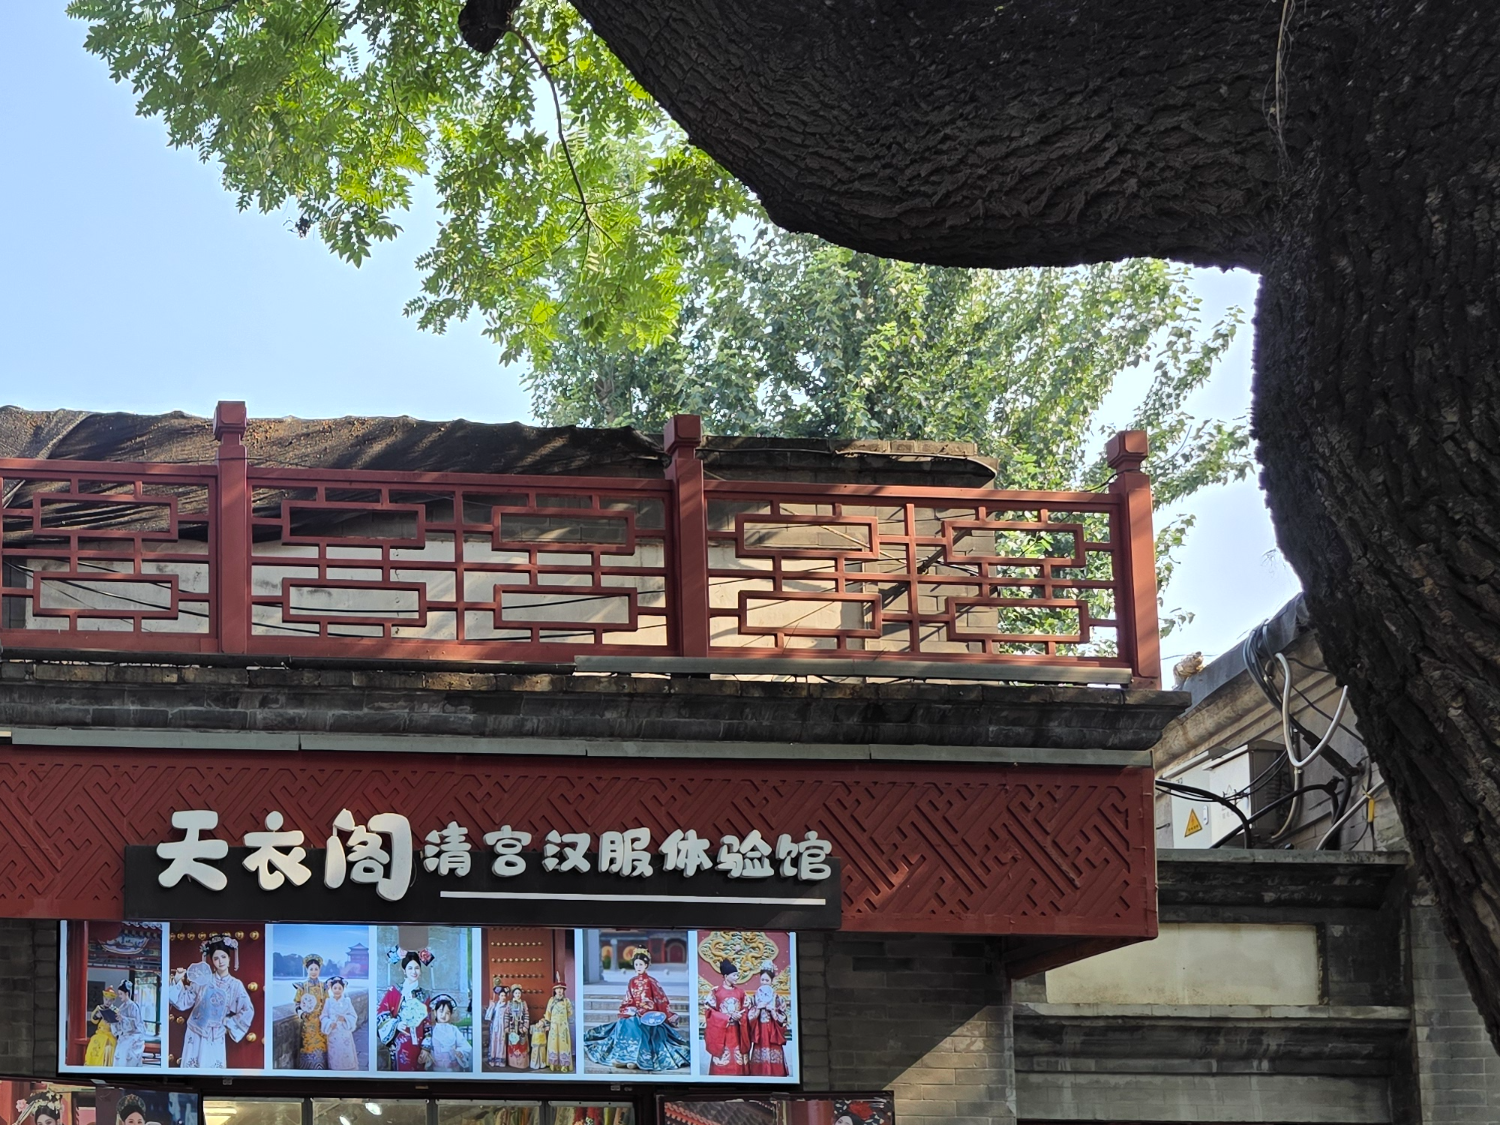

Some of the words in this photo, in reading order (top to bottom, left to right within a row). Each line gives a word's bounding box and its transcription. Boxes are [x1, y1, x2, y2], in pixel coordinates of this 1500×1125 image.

[156, 808, 413, 901] 天衣阁
[423, 820, 834, 881] 清宫汉服体验馆
